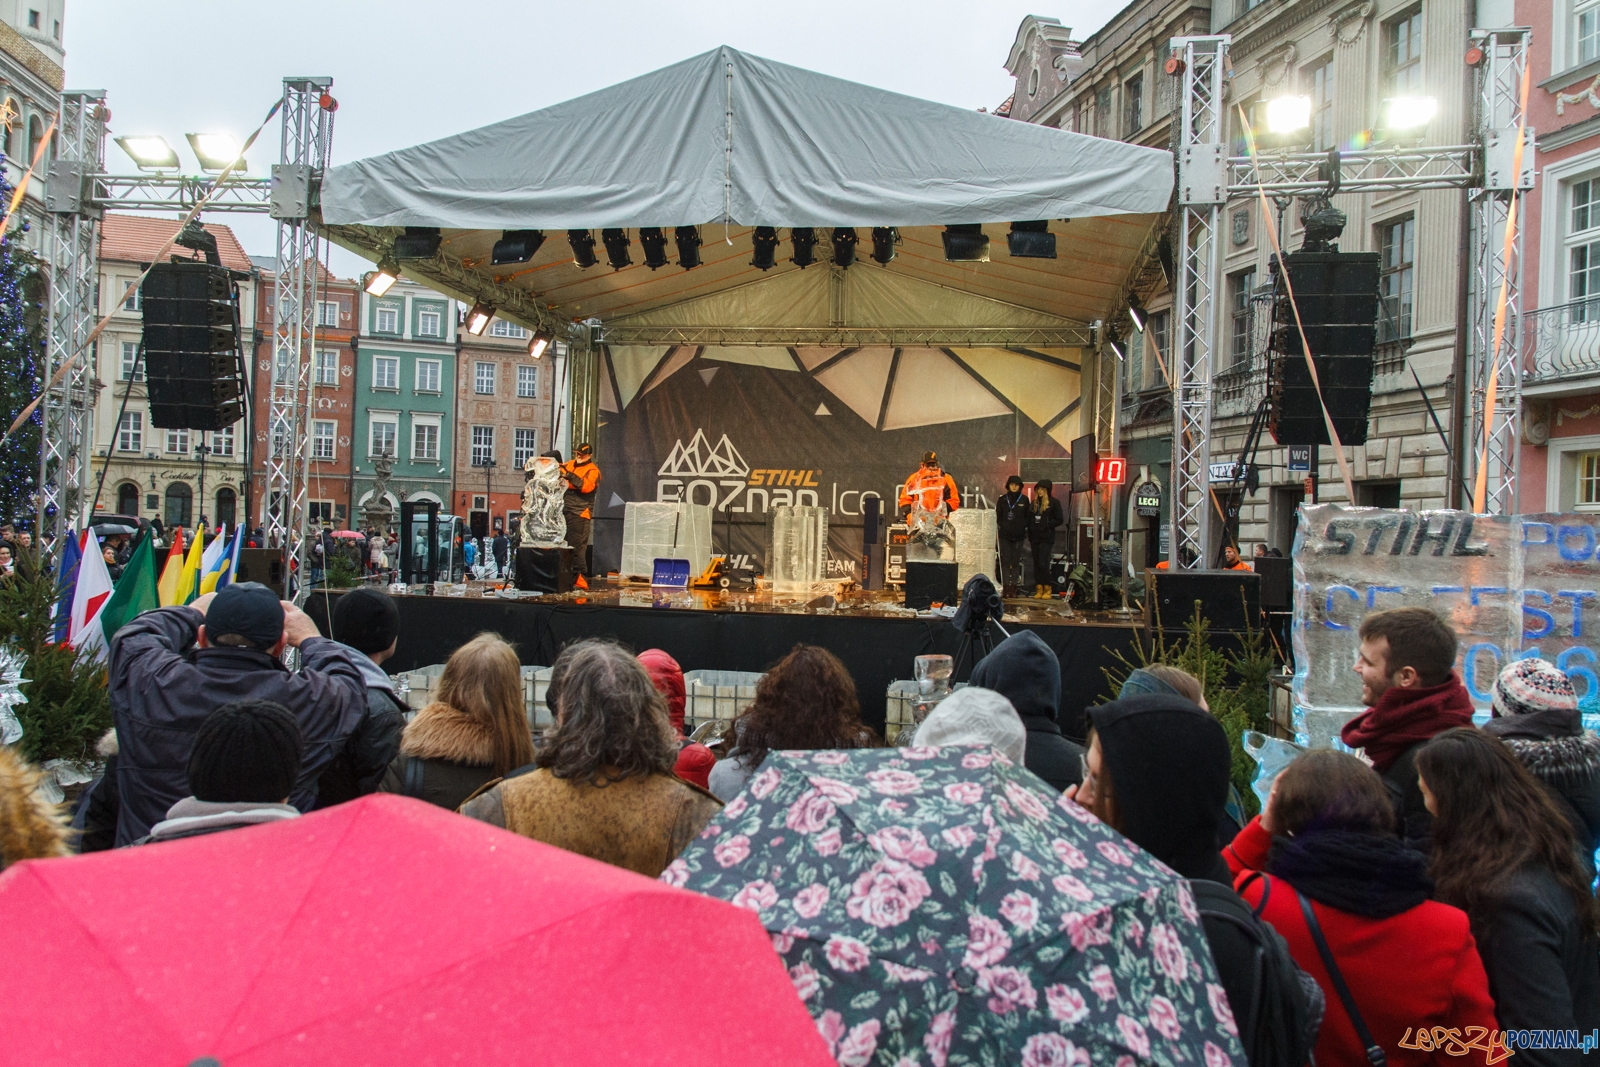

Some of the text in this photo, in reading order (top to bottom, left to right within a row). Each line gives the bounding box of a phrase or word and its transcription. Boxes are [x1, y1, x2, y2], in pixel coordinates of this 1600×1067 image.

[1292, 450, 1308, 460] WC
[747, 469, 819, 486] STIHL
[1099, 461, 1121, 481] 10
[1138, 498, 1159, 506] LECH
[1325, 515, 1600, 562] STIHL PO
[827, 560, 855, 571] EAM
